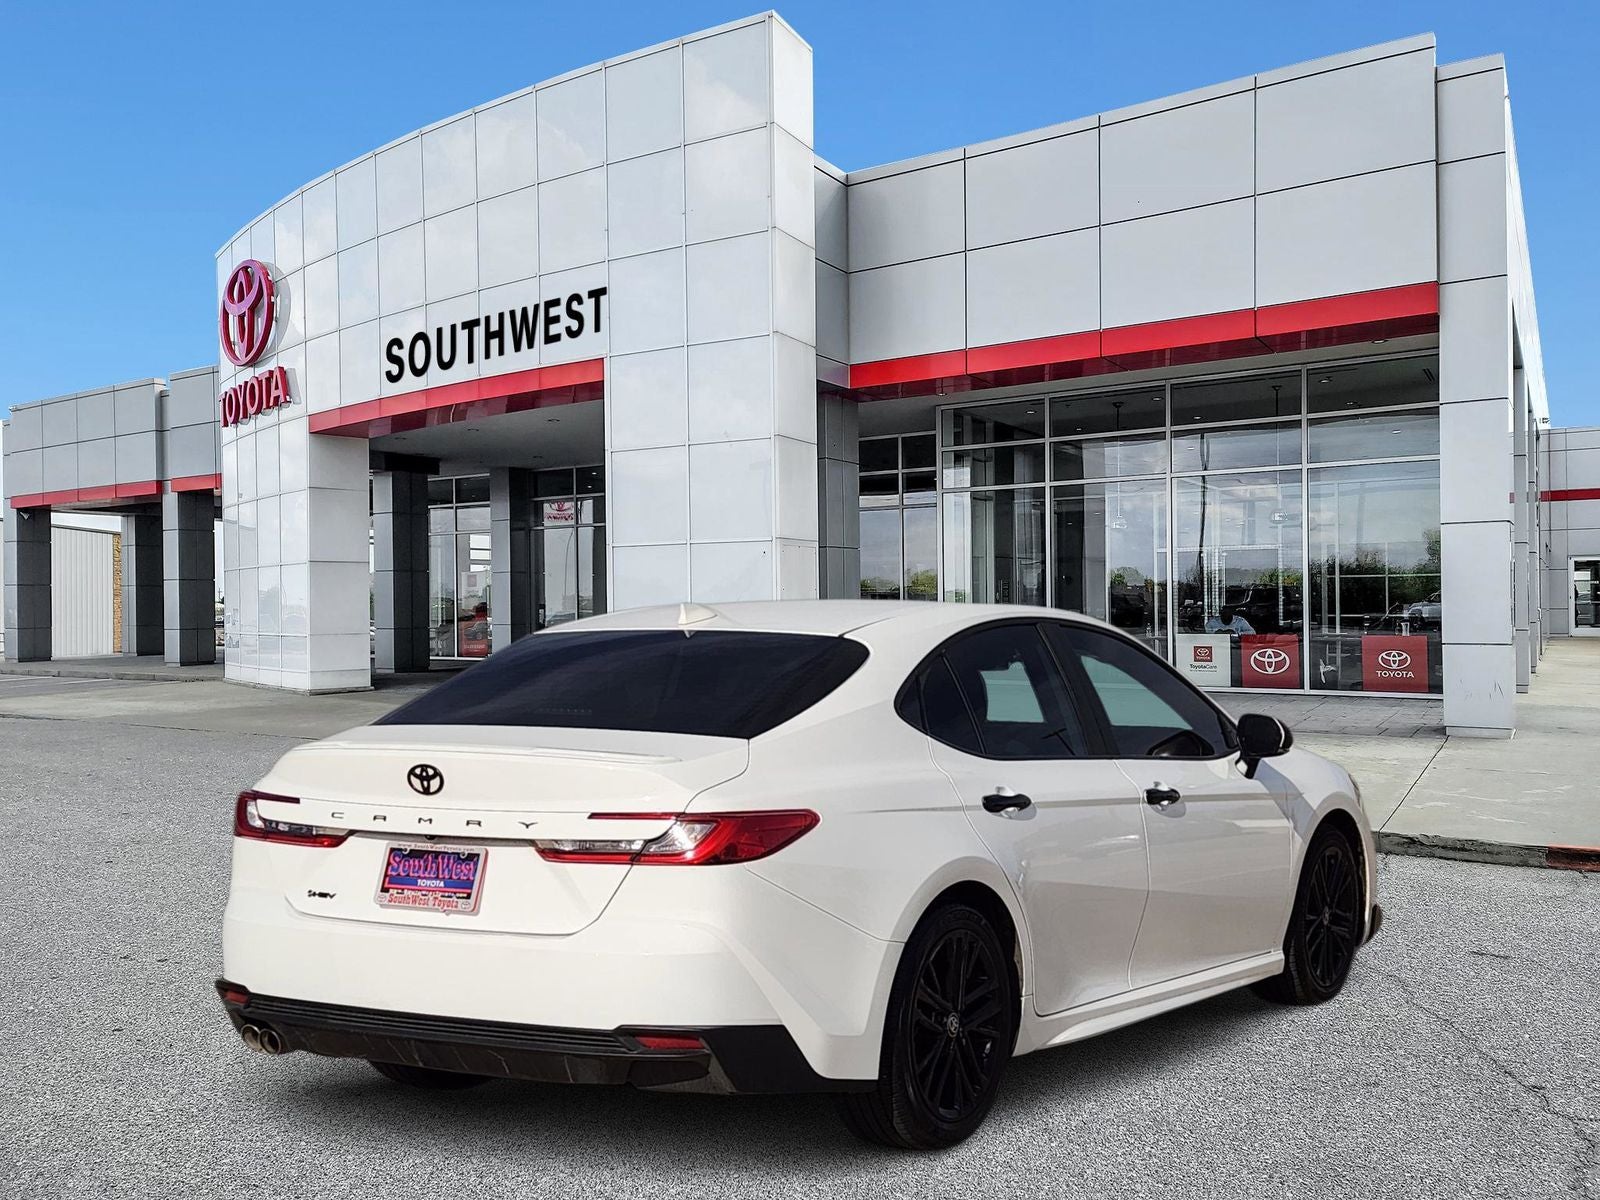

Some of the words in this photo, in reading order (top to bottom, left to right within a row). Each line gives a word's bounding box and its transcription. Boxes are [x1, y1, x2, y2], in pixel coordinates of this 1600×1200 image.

[384, 286, 608, 384] SOUTHWEST
[219, 366, 292, 428] TOYOTA
[1375, 670, 1415, 679] TOYOTA
[331, 811, 538, 829] CAMRY
[387, 851, 480, 880] SouthWest
[417, 879, 445, 888] TOYOTA
[387, 893, 430, 907] SouthWest
[432, 896, 459, 910] Toyota
